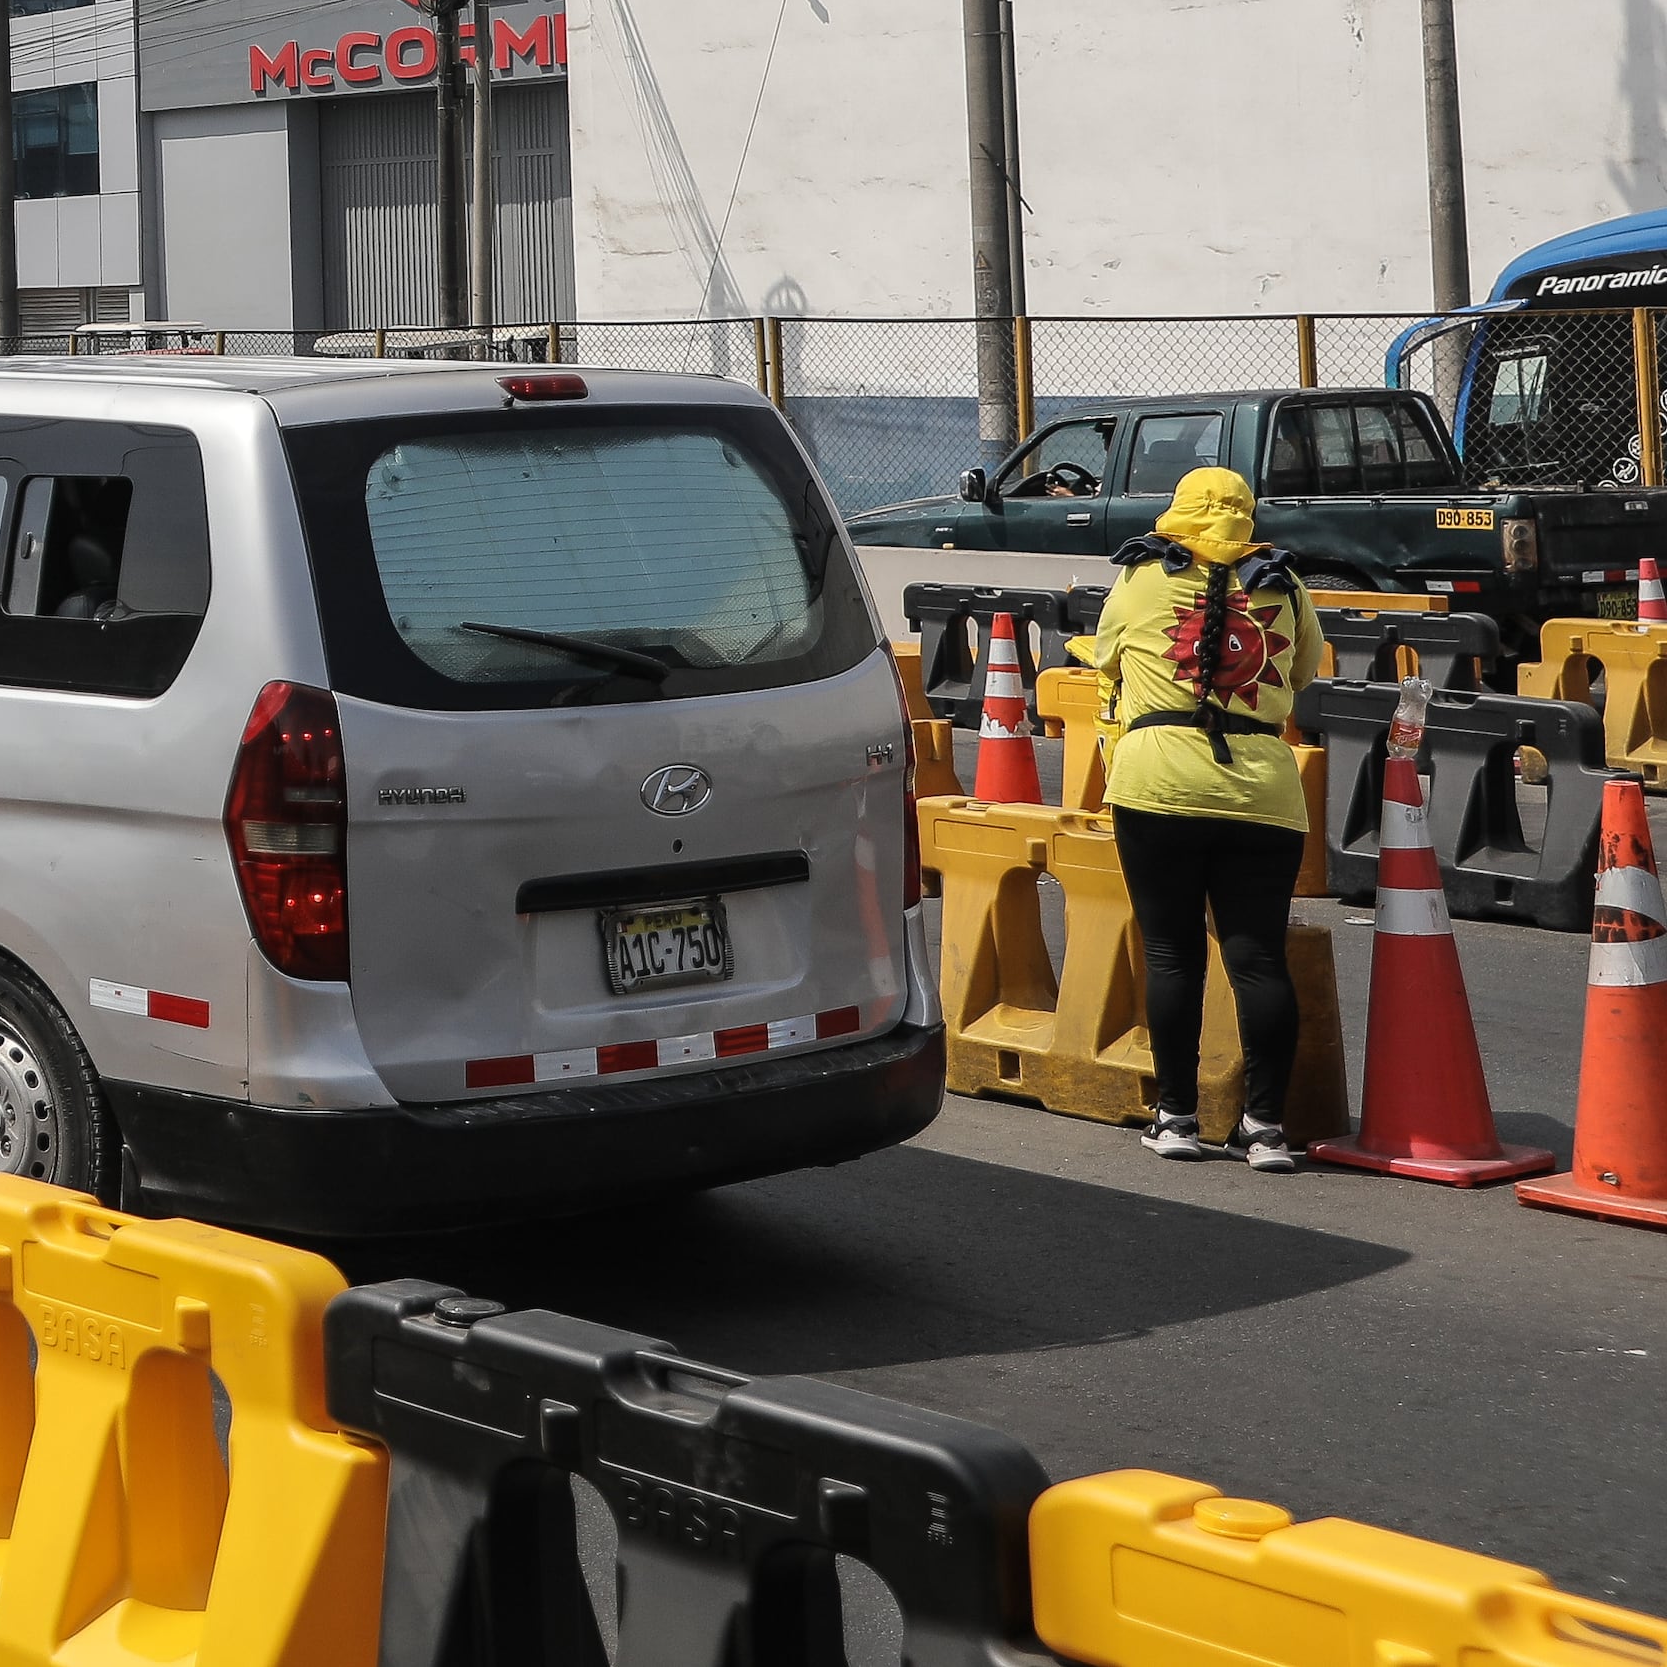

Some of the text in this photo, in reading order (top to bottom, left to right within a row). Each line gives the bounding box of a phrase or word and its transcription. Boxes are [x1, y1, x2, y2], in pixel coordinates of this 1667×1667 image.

[378, 787, 467, 806] HYUNDAI
[618, 923, 723, 980] A1C-750
[38, 1303, 127, 1370] BASA
